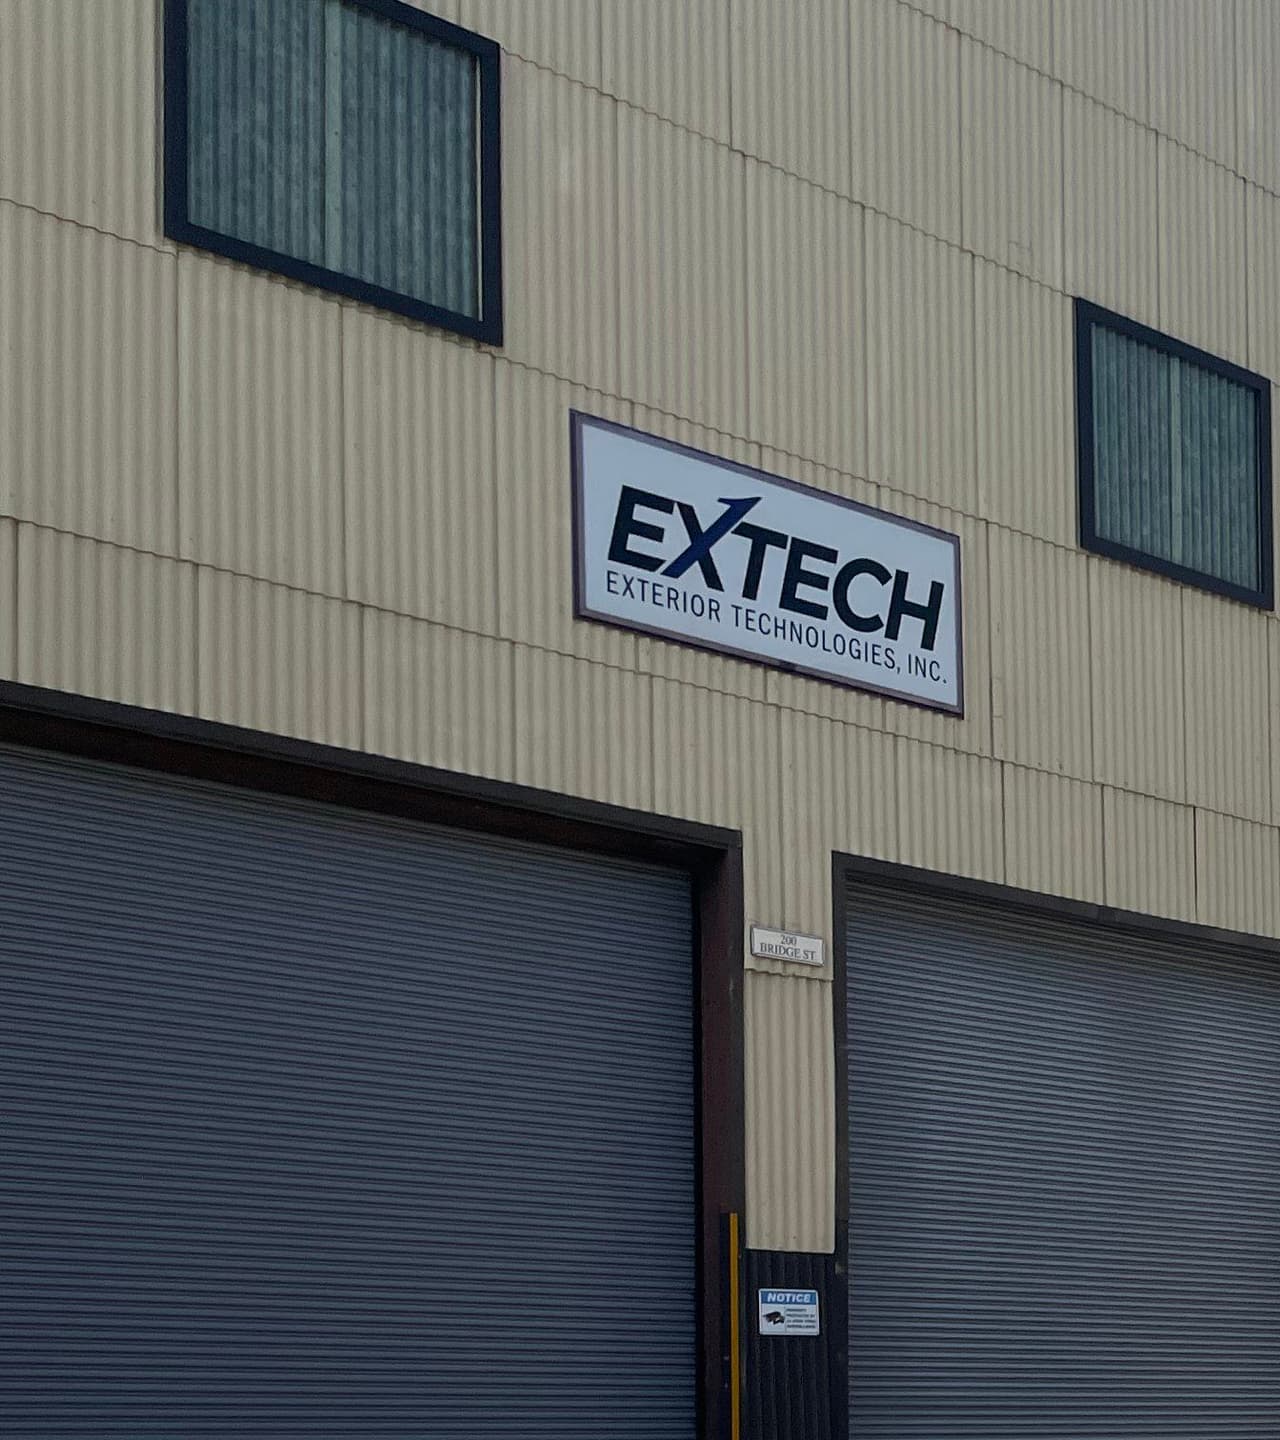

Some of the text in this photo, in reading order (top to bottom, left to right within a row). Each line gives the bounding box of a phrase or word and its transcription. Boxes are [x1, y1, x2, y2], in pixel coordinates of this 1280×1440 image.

[607, 484, 945, 652] EXTECH
[606, 571, 947, 684] EXTERIOR TECHNOLOGIES, INC.
[781, 935, 797, 945] 200
[760, 943, 816, 960] BRIDGE ST
[767, 1292, 811, 1303] NOTICE
